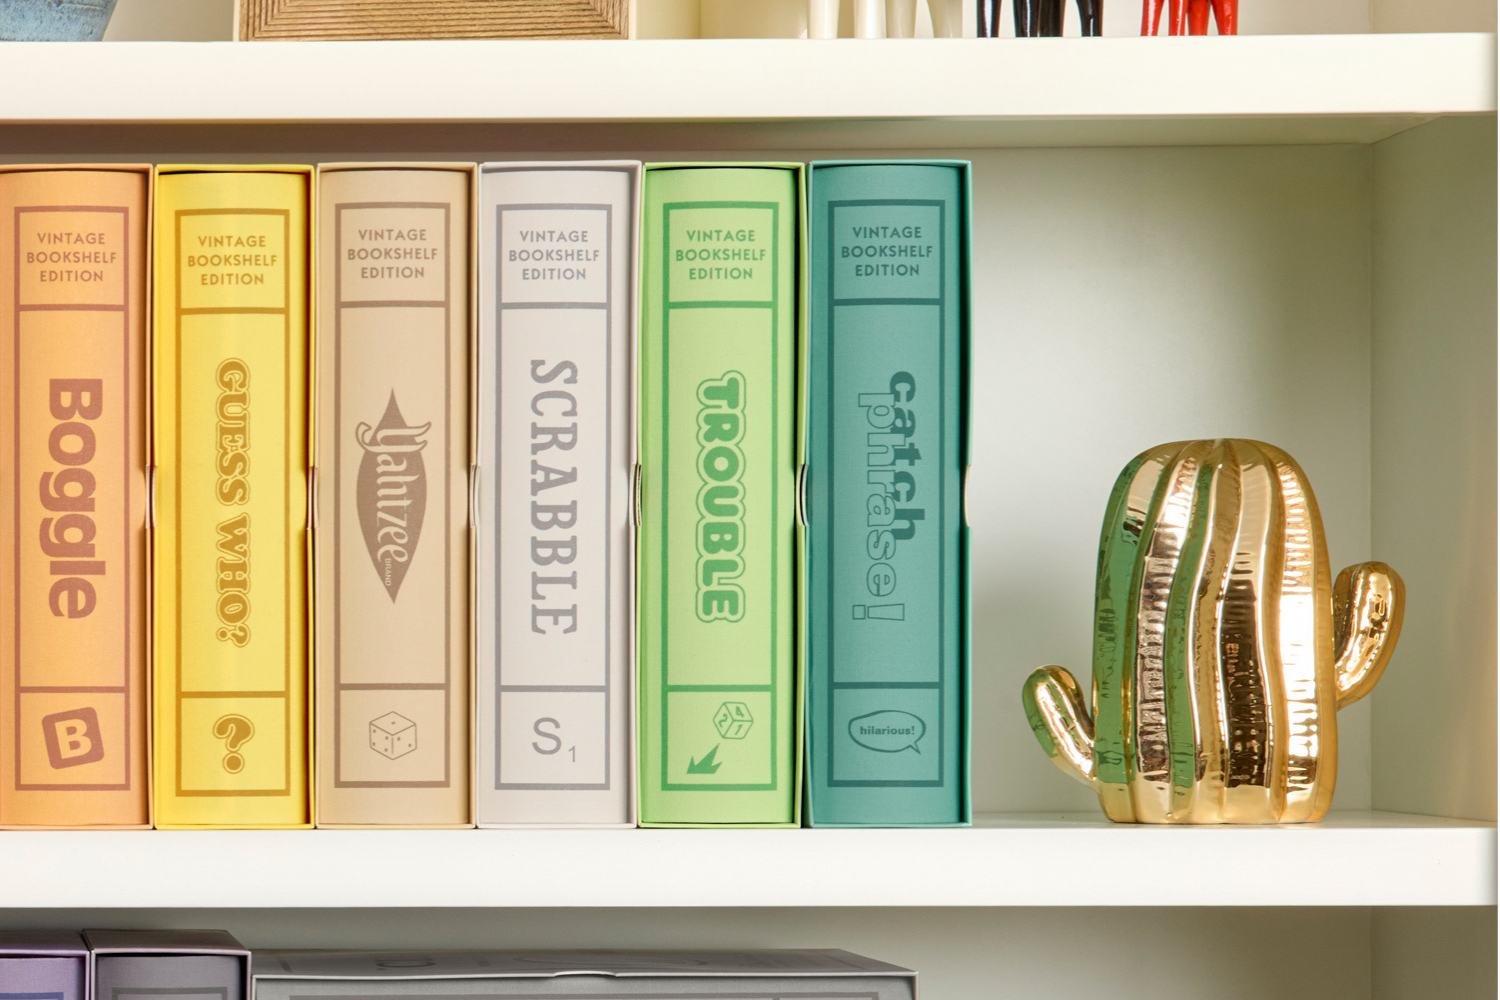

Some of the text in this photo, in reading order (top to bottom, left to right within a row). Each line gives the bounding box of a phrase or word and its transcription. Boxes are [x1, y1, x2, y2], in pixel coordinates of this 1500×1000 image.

[37, 232, 106, 245] VINTAGE
[358, 229, 427, 242] VINTAGE
[519, 230, 588, 243] VINTAGE
[686, 230, 756, 242] VINTAGE
[852, 226, 922, 239] VINTAGE
[198, 236, 266, 248] VINTAGE
[26, 251, 117, 264] BOOKSHELF
[347, 248, 438, 261] BOOKSHELF
[509, 249, 600, 262] BOOKSHELF
[676, 248, 766, 262] BOOKSHELF
[841, 245, 933, 258] BOOKSHELF
[188, 254, 278, 268] BOOKSHELF
[40, 270, 104, 282] EDITION
[360, 267, 424, 279] EDITION
[522, 268, 586, 280] EDITION
[689, 268, 753, 280] EDITION
[855, 264, 920, 276] EDITION
[200, 274, 264, 286] EDITION
[890, 371, 926, 541] catch
[40, 378, 106, 619] Boggle
[355, 421, 432, 563] Yahtzee
[530, 359, 578, 635] SCRABBLE
[696, 370, 746, 623] TROUBLE
[215, 357, 251, 647] GUESS WHO?
[852, 392, 905, 621] phrase!
[384, 558, 392, 587] BRAND
[860, 725, 915, 736] hilarious!
[54, 718, 93, 760] B
